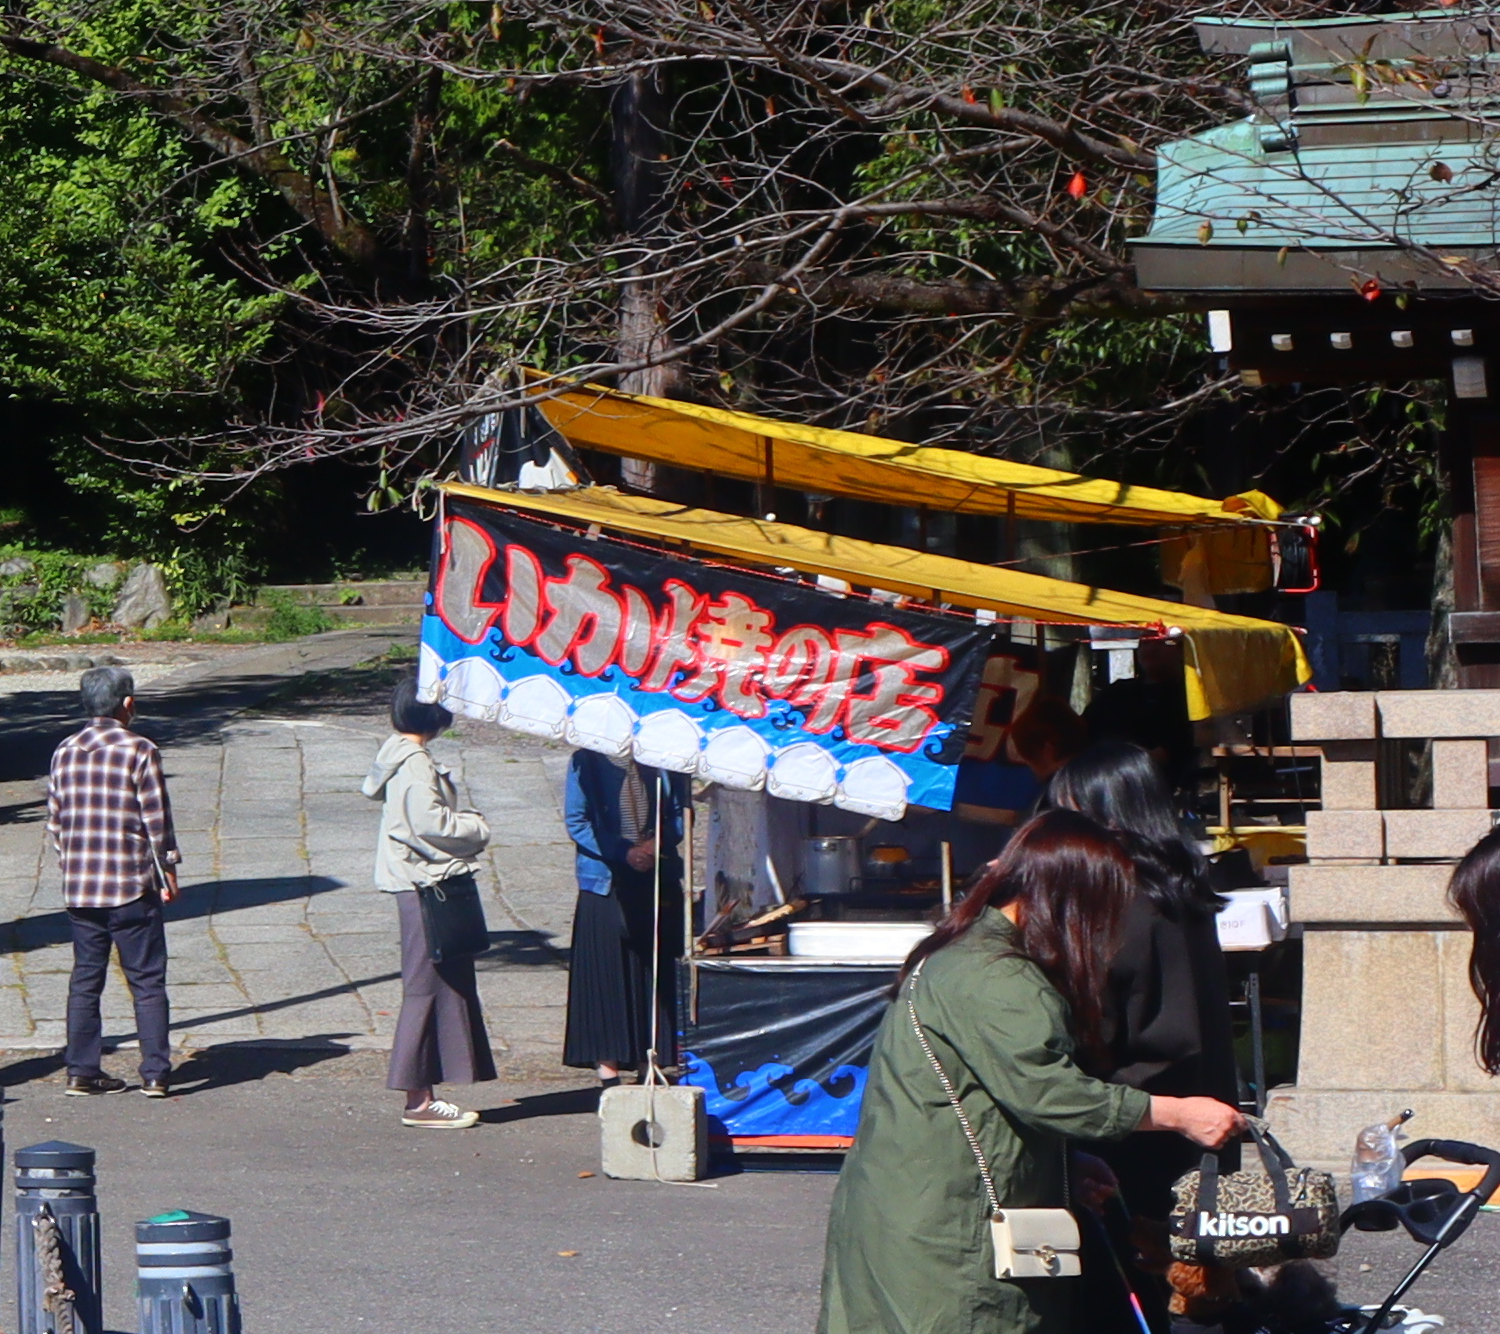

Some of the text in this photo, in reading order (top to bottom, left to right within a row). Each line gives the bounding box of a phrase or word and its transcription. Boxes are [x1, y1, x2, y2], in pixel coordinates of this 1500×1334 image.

[435, 514, 950, 754] いか焼の店
[1199, 1211, 1291, 1237] kitson
